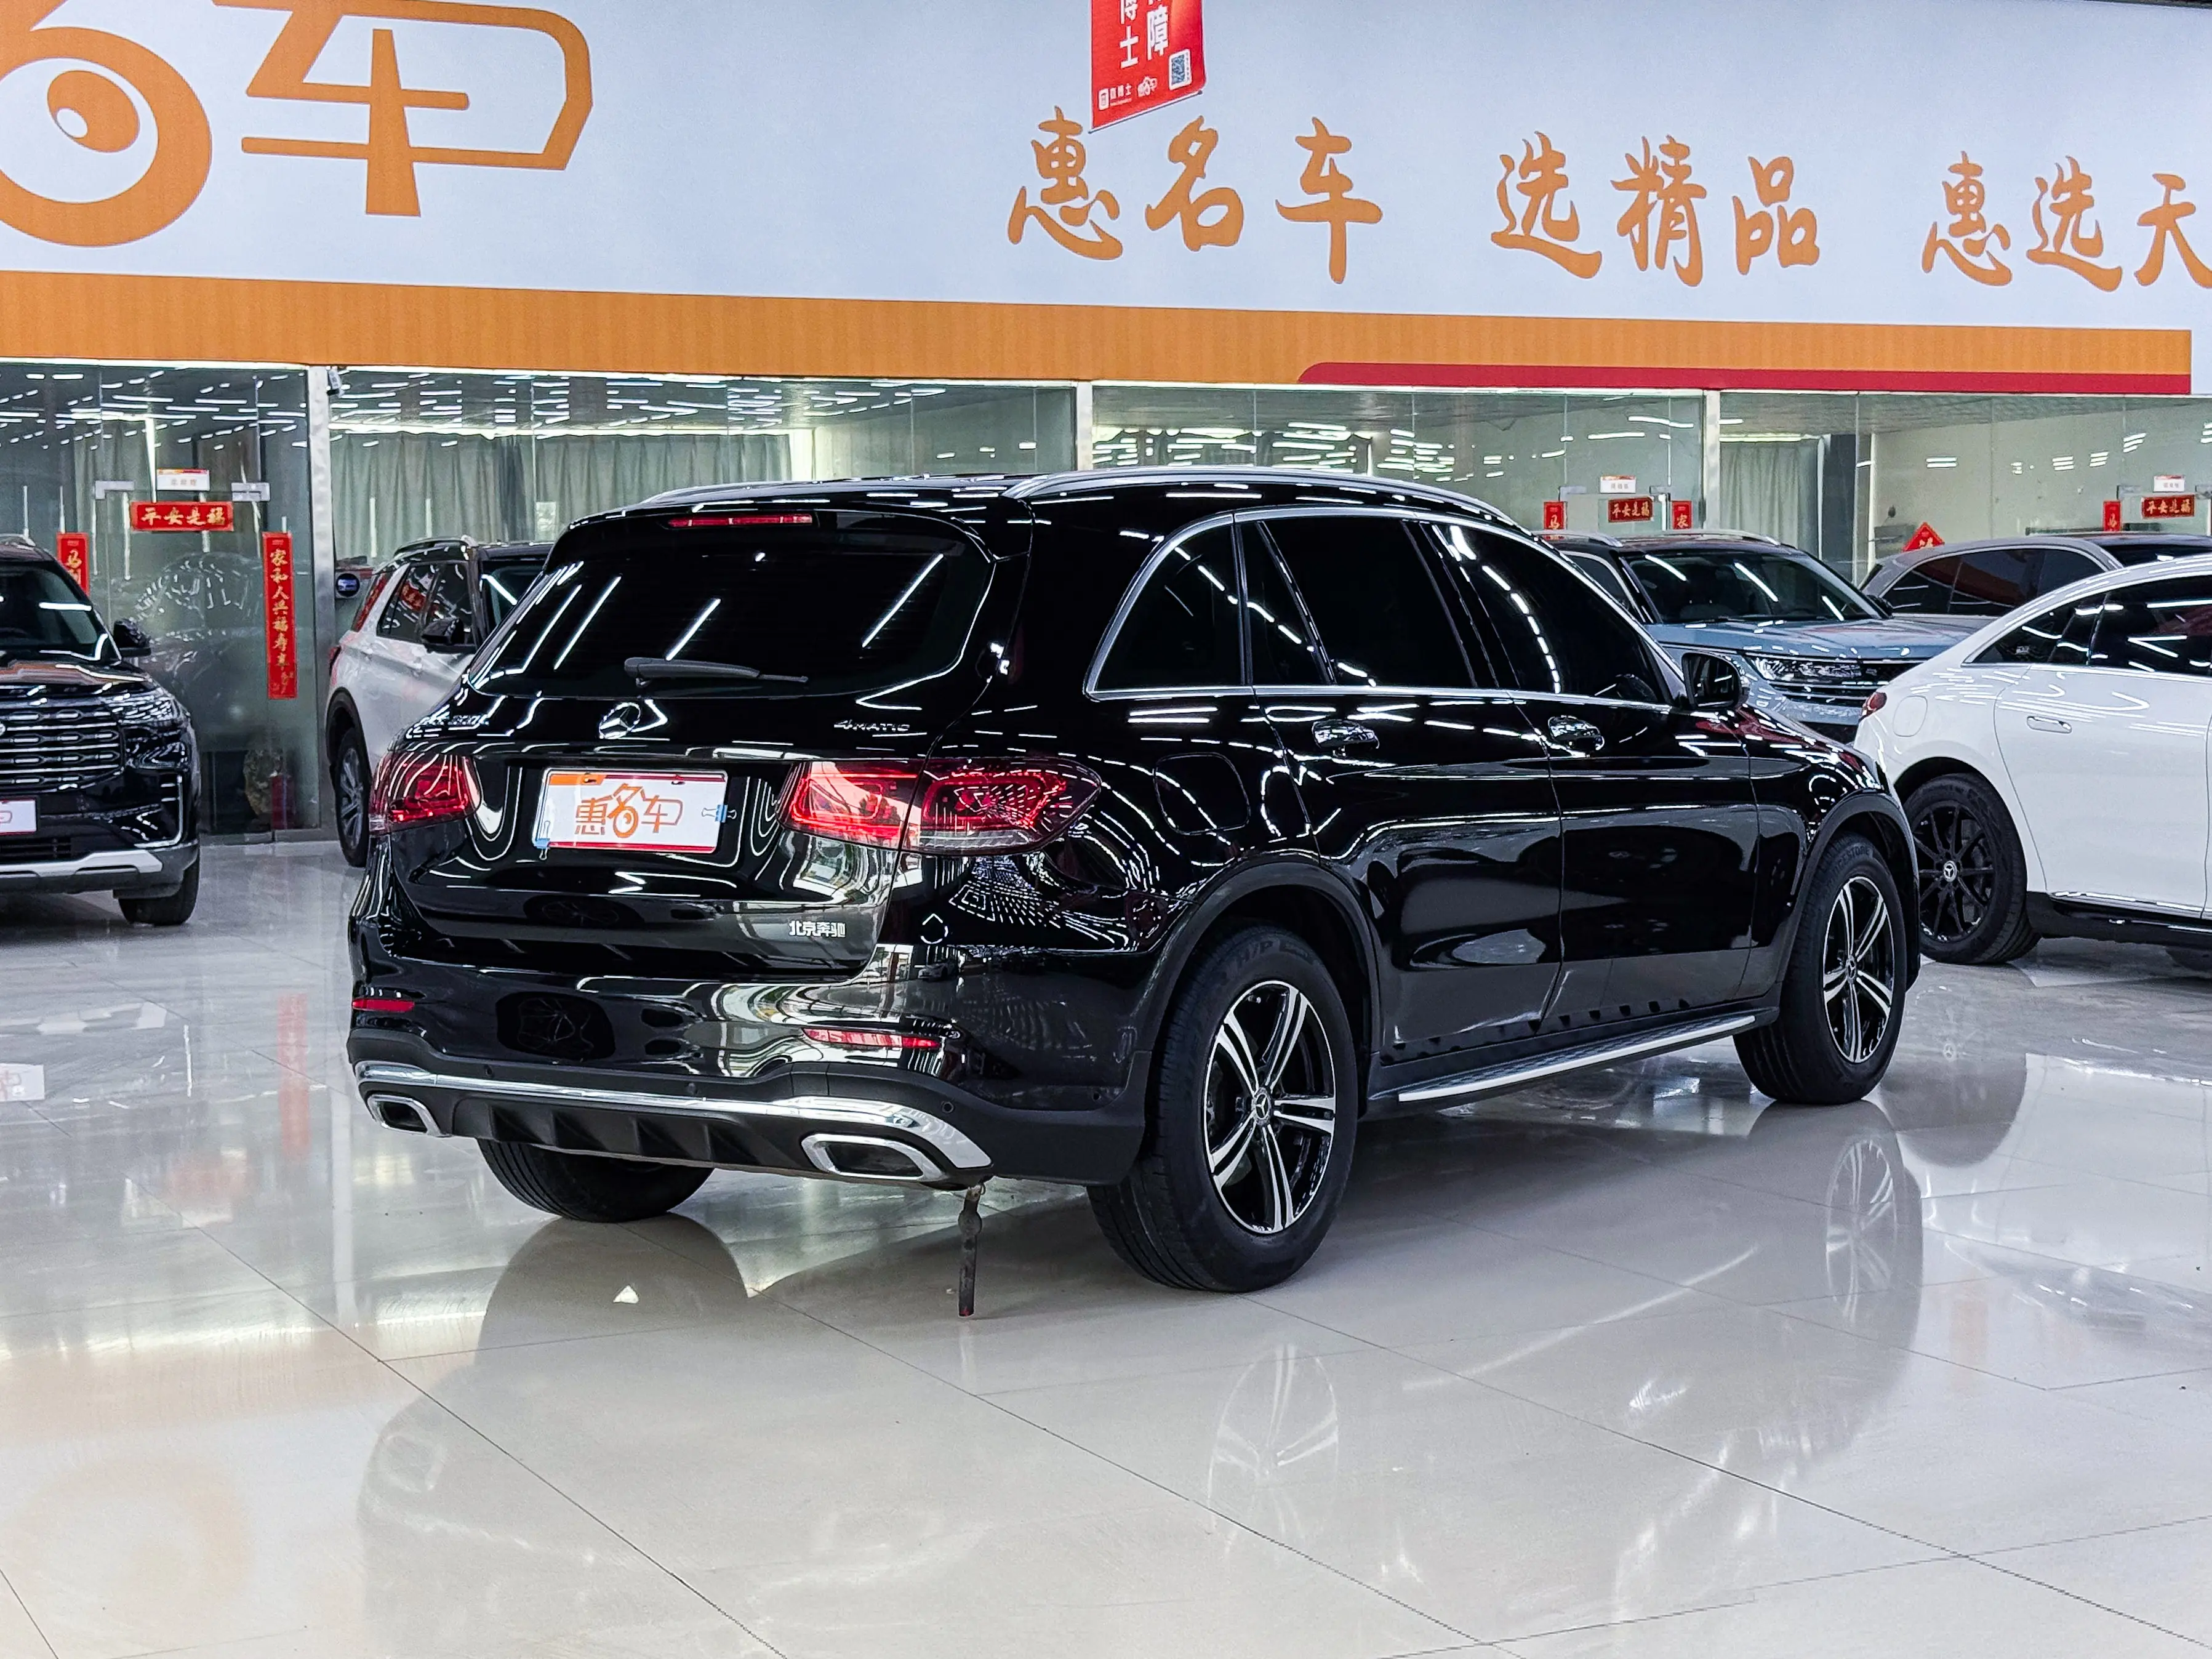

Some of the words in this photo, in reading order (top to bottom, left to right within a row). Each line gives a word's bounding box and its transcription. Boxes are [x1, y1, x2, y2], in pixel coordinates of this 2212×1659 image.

[1147, 0, 1169, 60] 障
[1008, 105, 1383, 284] 惠名车
[1491, 131, 1820, 287] 选精品
[1921, 151, 2212, 292] 惠选天
[141, 506, 225, 525] 平安是福
[1612, 500, 1650, 518] 平安是福
[2146, 498, 2191, 515] 平安是福
[1677, 513, 1689, 528] 家
[833, 718, 910, 731] 4MATIC
[574, 782, 684, 839] 惠名车
[788, 920, 846, 938] 北京奔驰
